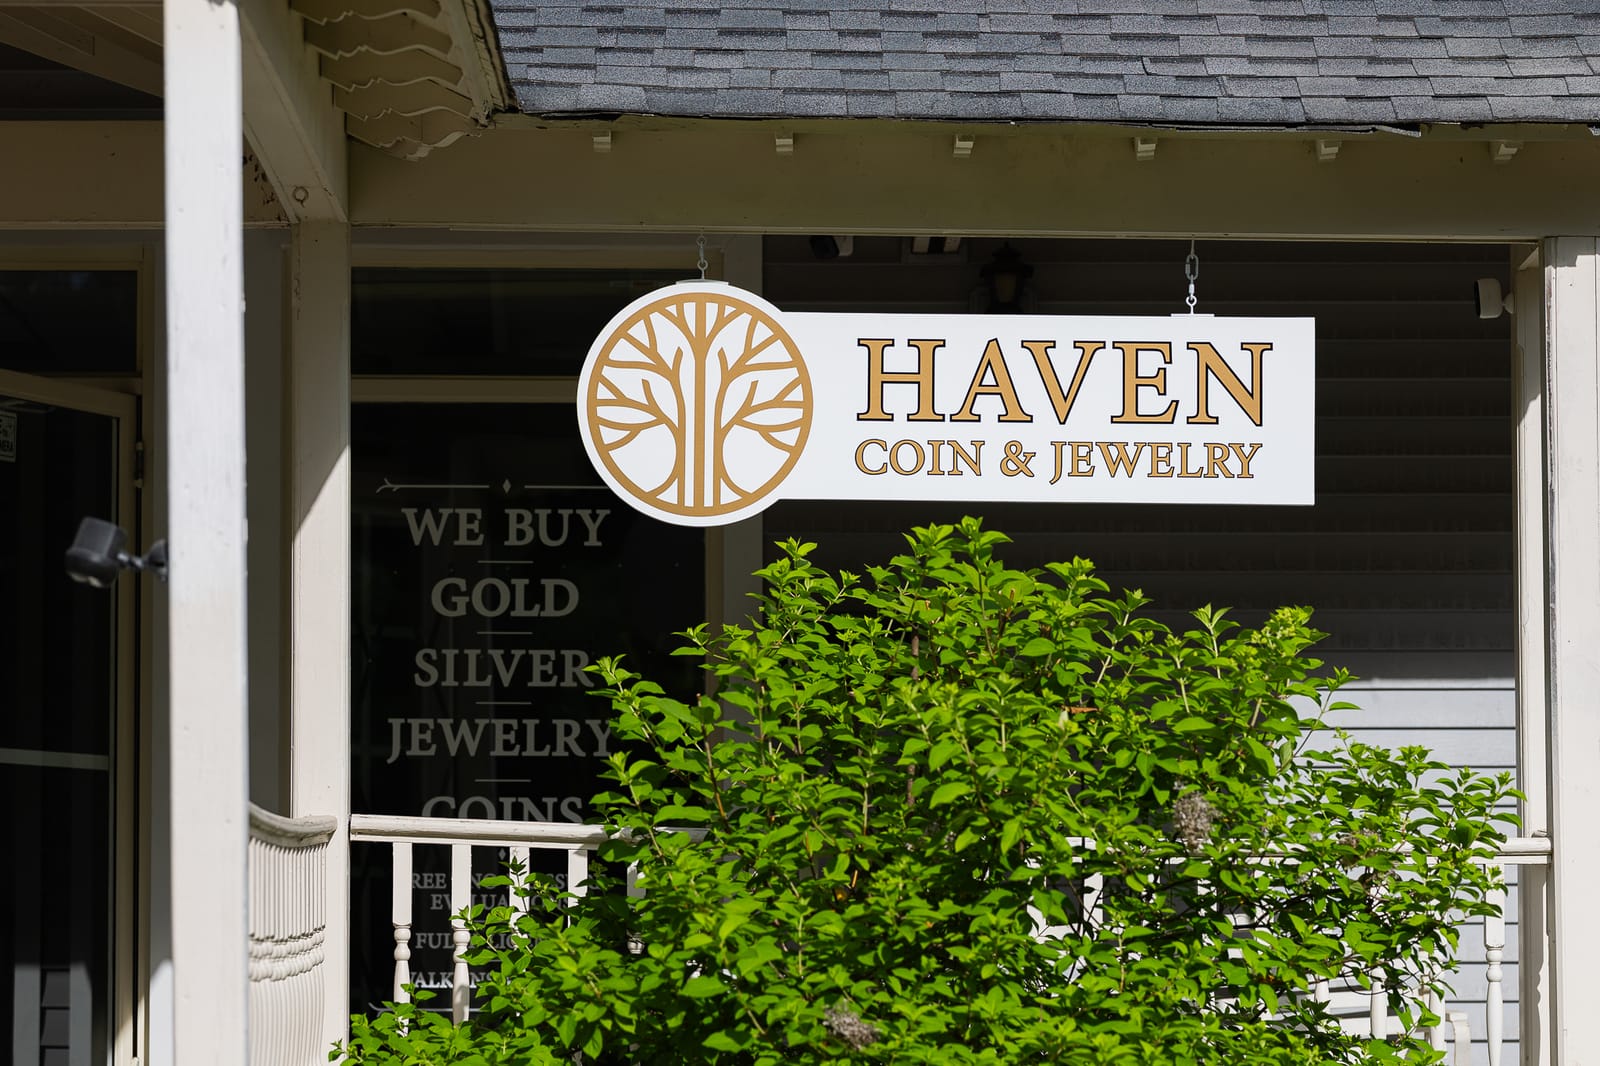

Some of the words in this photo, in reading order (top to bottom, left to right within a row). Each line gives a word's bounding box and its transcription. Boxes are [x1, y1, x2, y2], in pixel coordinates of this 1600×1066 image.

[857, 338, 1274, 427] HAVEN
[854, 438, 986, 477] COIN
[1000, 439, 1037, 478] &
[1049, 440, 1264, 485] JEWELRY
[401, 507, 484, 547] WE
[504, 508, 611, 547] BUY
[430, 577, 580, 618] GOLD
[414, 648, 595, 688] SILVER
[386, 718, 612, 764] JEWELRY
[411, 873, 447, 889] REE
